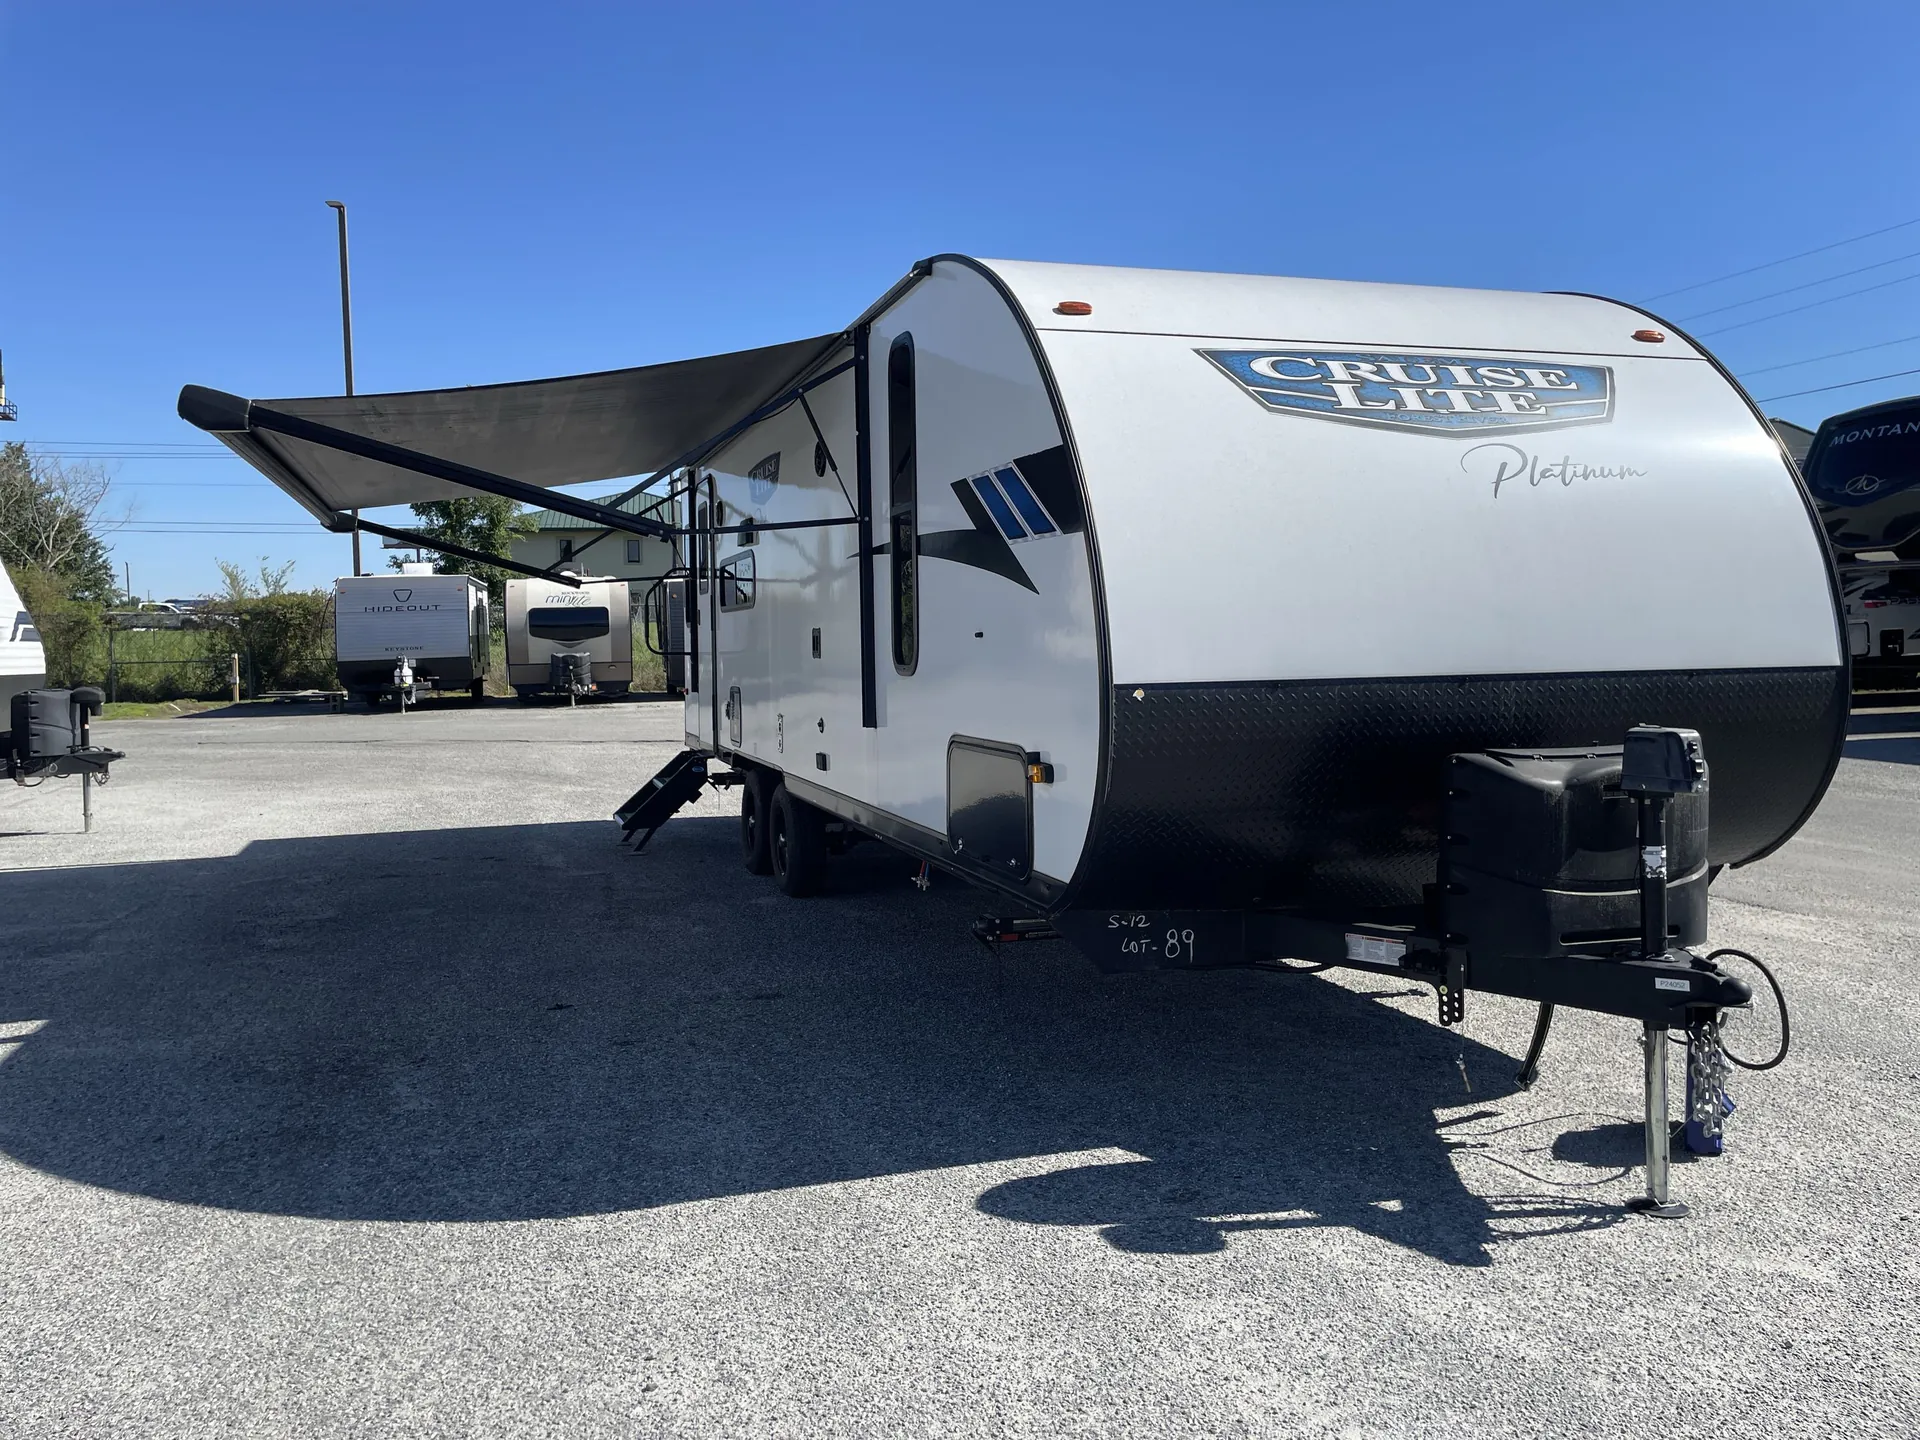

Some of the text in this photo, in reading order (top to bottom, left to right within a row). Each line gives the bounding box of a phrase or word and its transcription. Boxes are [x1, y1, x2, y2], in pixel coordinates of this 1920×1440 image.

[1249, 356, 1578, 390] CRUISE
[1321, 382, 1547, 416] LITE
[1461, 442, 1649, 499] Platinum
[364, 604, 441, 613] HIDEOUT
[1107, 914, 1151, 928] S-12
